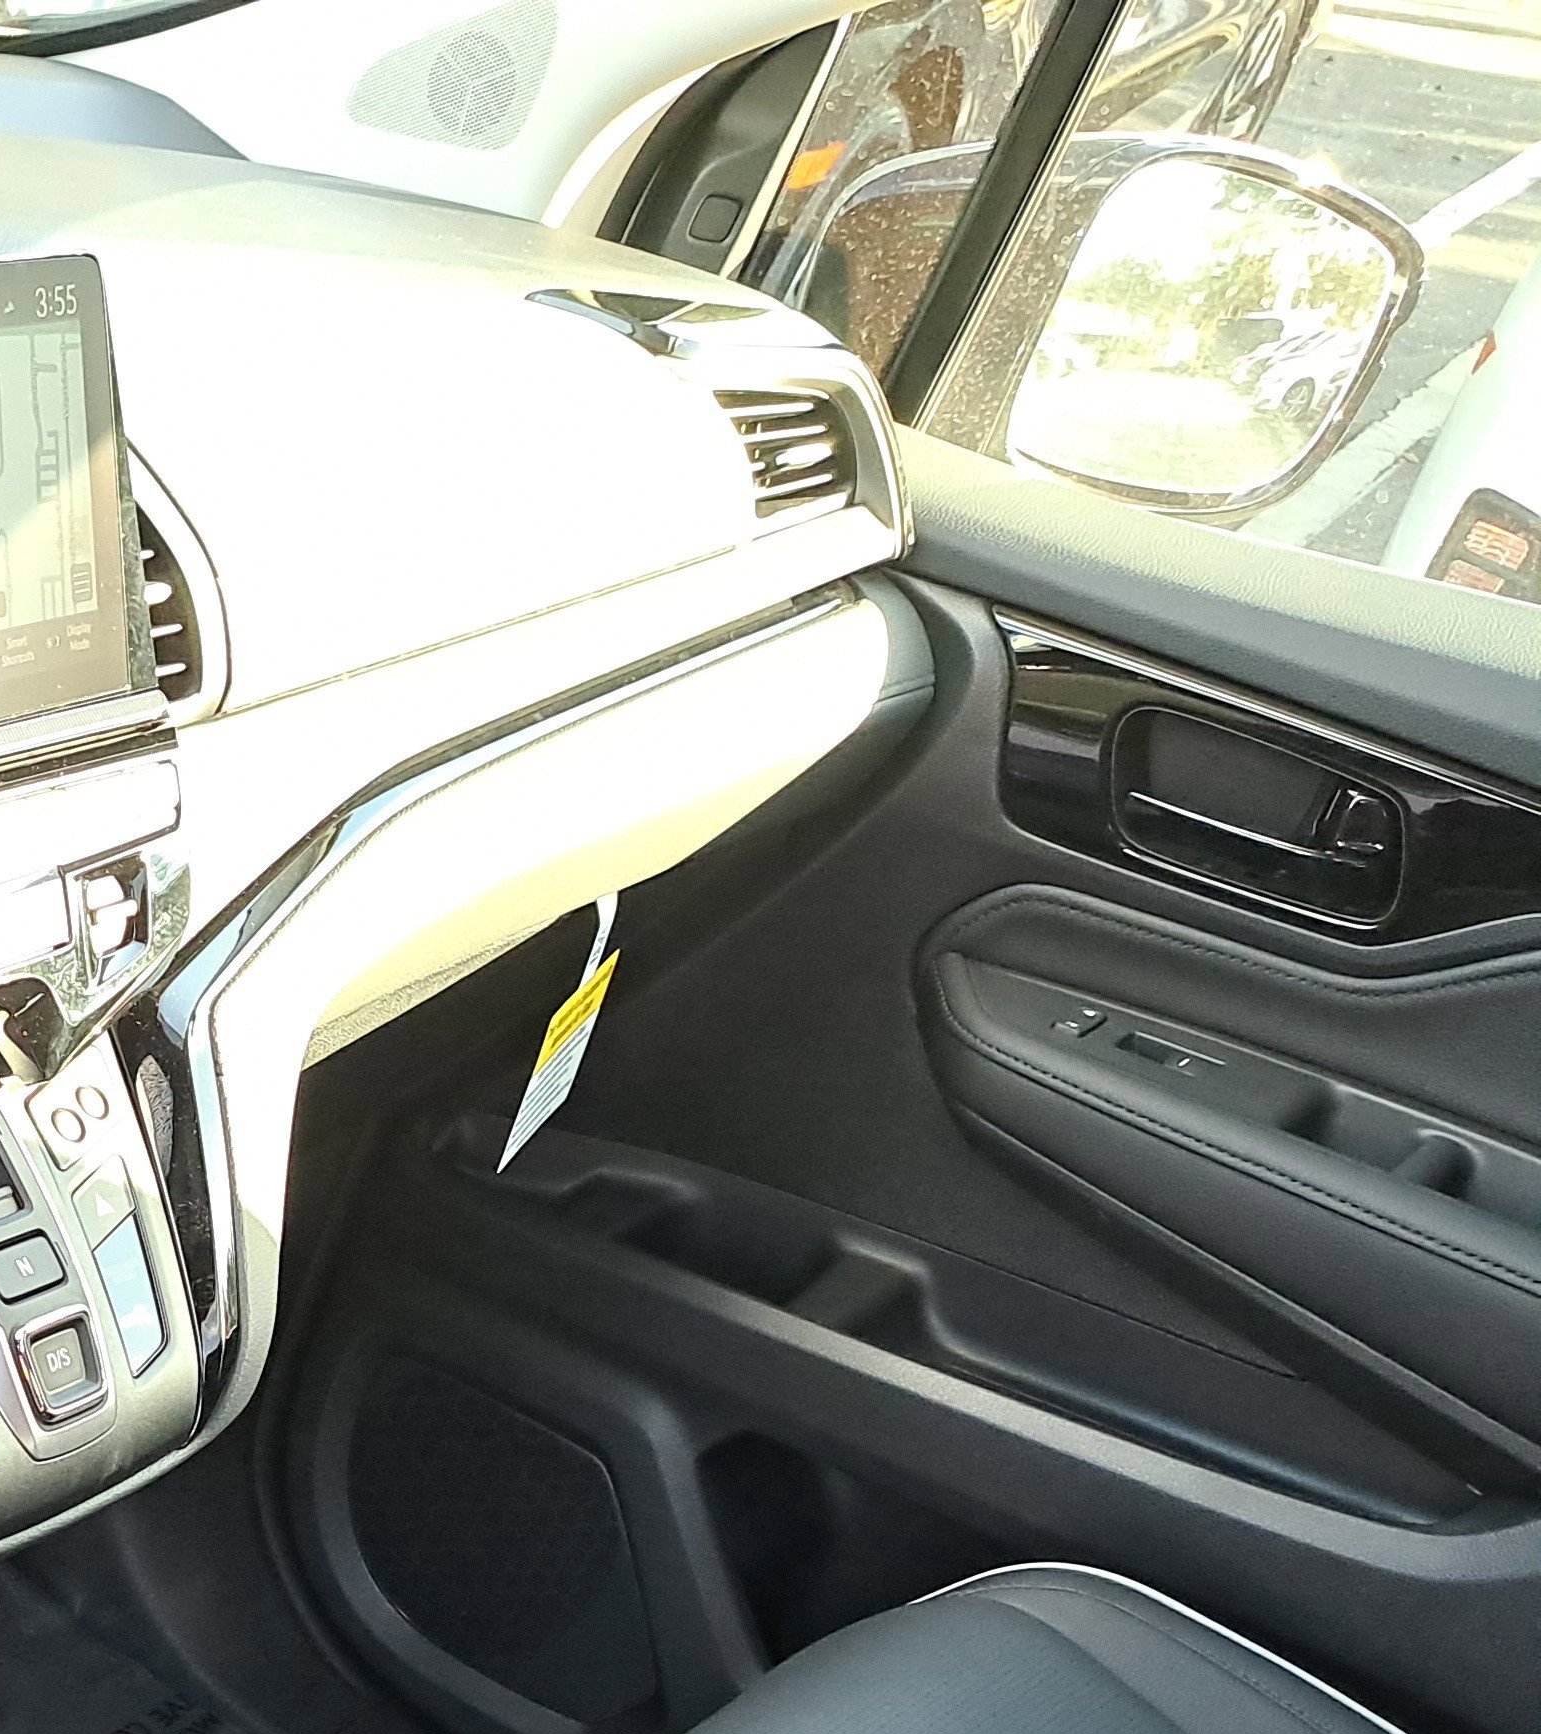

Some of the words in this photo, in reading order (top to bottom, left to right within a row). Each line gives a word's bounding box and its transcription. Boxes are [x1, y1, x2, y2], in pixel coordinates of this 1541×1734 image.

[34, 284, 78, 319] 3:55
[14, 1257, 34, 1277] N
[46, 1345, 72, 1373] D/S
